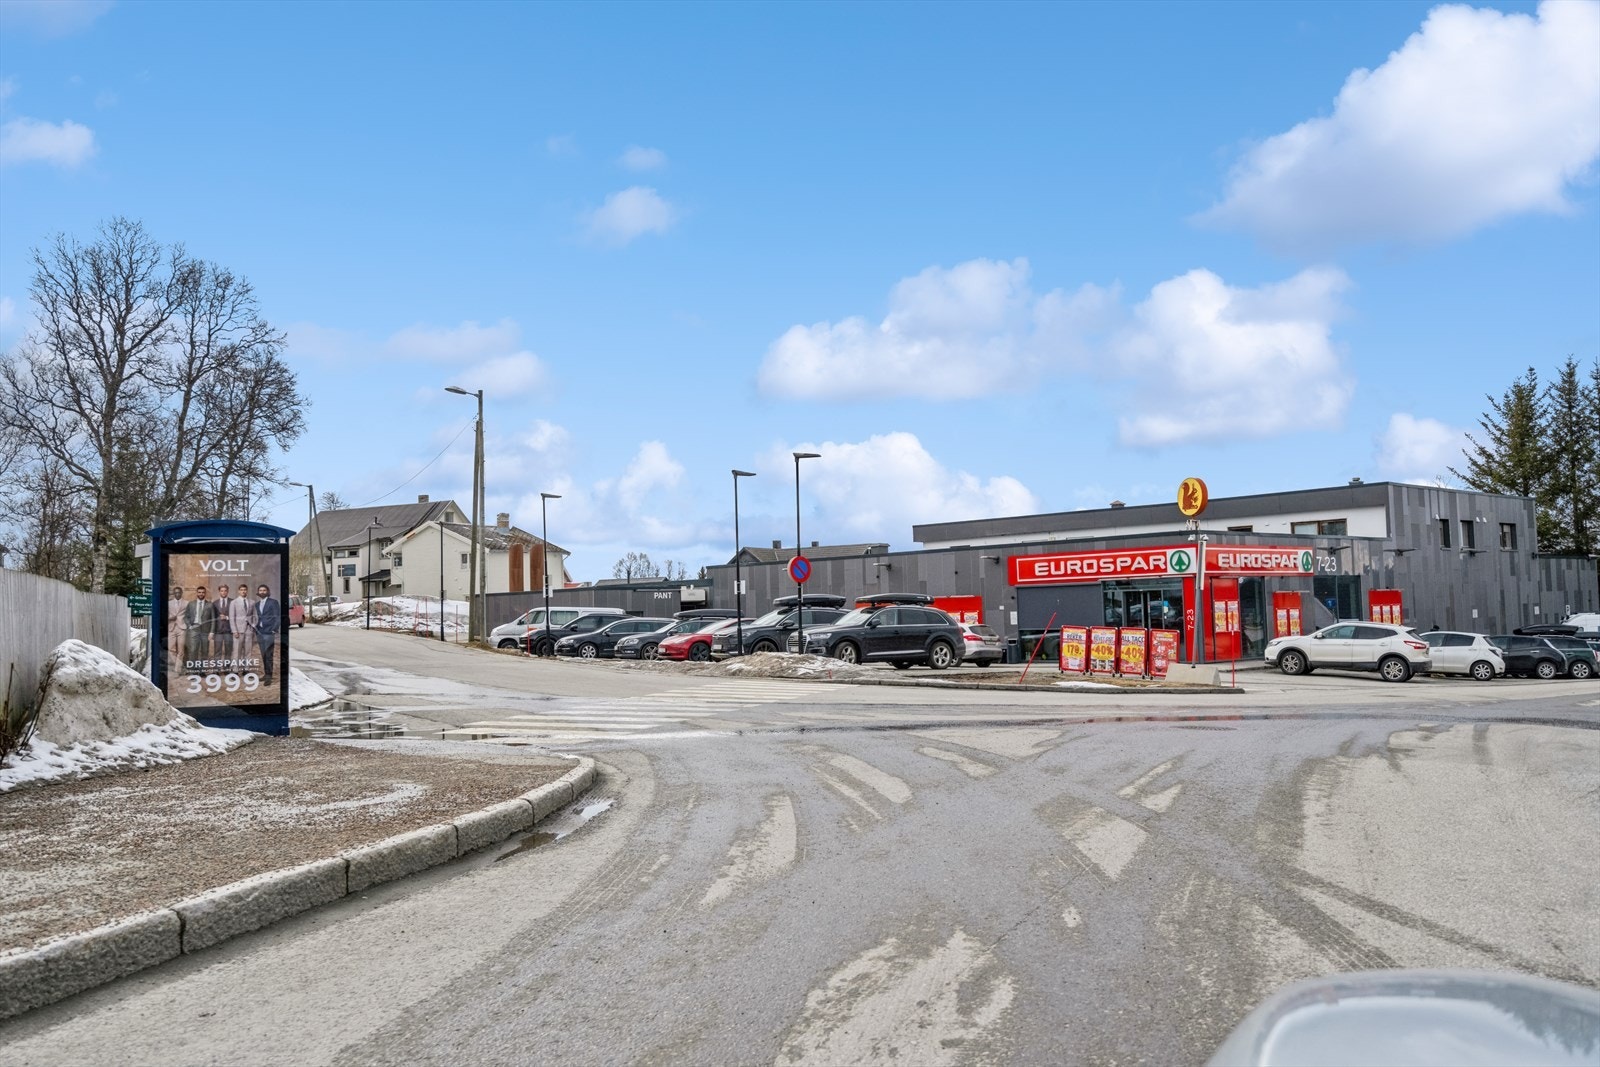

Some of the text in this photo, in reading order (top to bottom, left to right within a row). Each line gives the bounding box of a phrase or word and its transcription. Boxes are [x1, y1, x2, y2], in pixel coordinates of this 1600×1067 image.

[199, 559, 249, 572] VOLT
[1034, 555, 1167, 577] EUROSPAR
[1217, 553, 1300, 568] EUROSPAR
[1316, 556, 1337, 572] 7-23
[1186, 608, 1195, 630] 7-23
[1092, 645, 1114, 656] -40%
[1121, 647, 1144, 658] -40%
[186, 658, 260, 668] DRESSPAKKE
[186, 672, 260, 694] 3999
